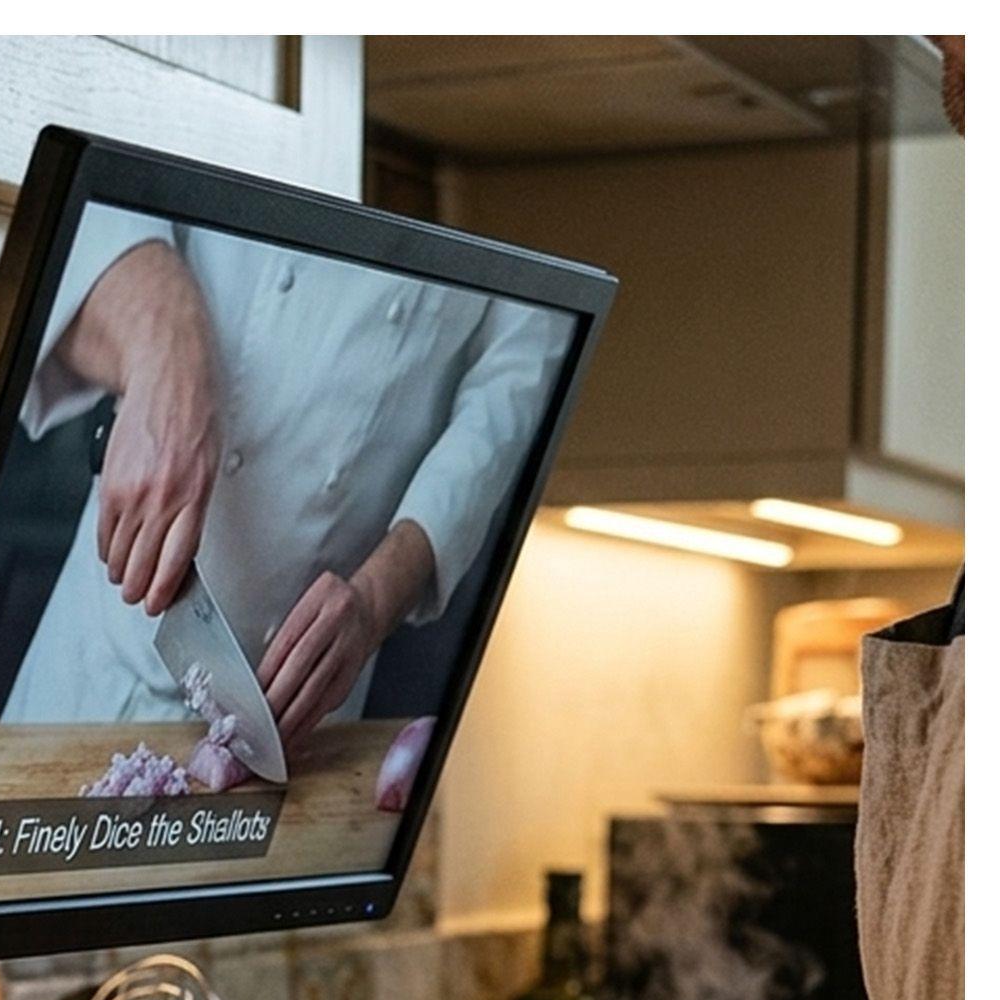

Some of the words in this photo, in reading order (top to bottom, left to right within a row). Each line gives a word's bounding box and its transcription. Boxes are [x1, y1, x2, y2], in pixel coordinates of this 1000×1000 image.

[12, 815, 88, 861] Finely
[89, 813, 143, 850] Dice
[146, 812, 184, 847] the
[186, 808, 271, 845] Shallots
